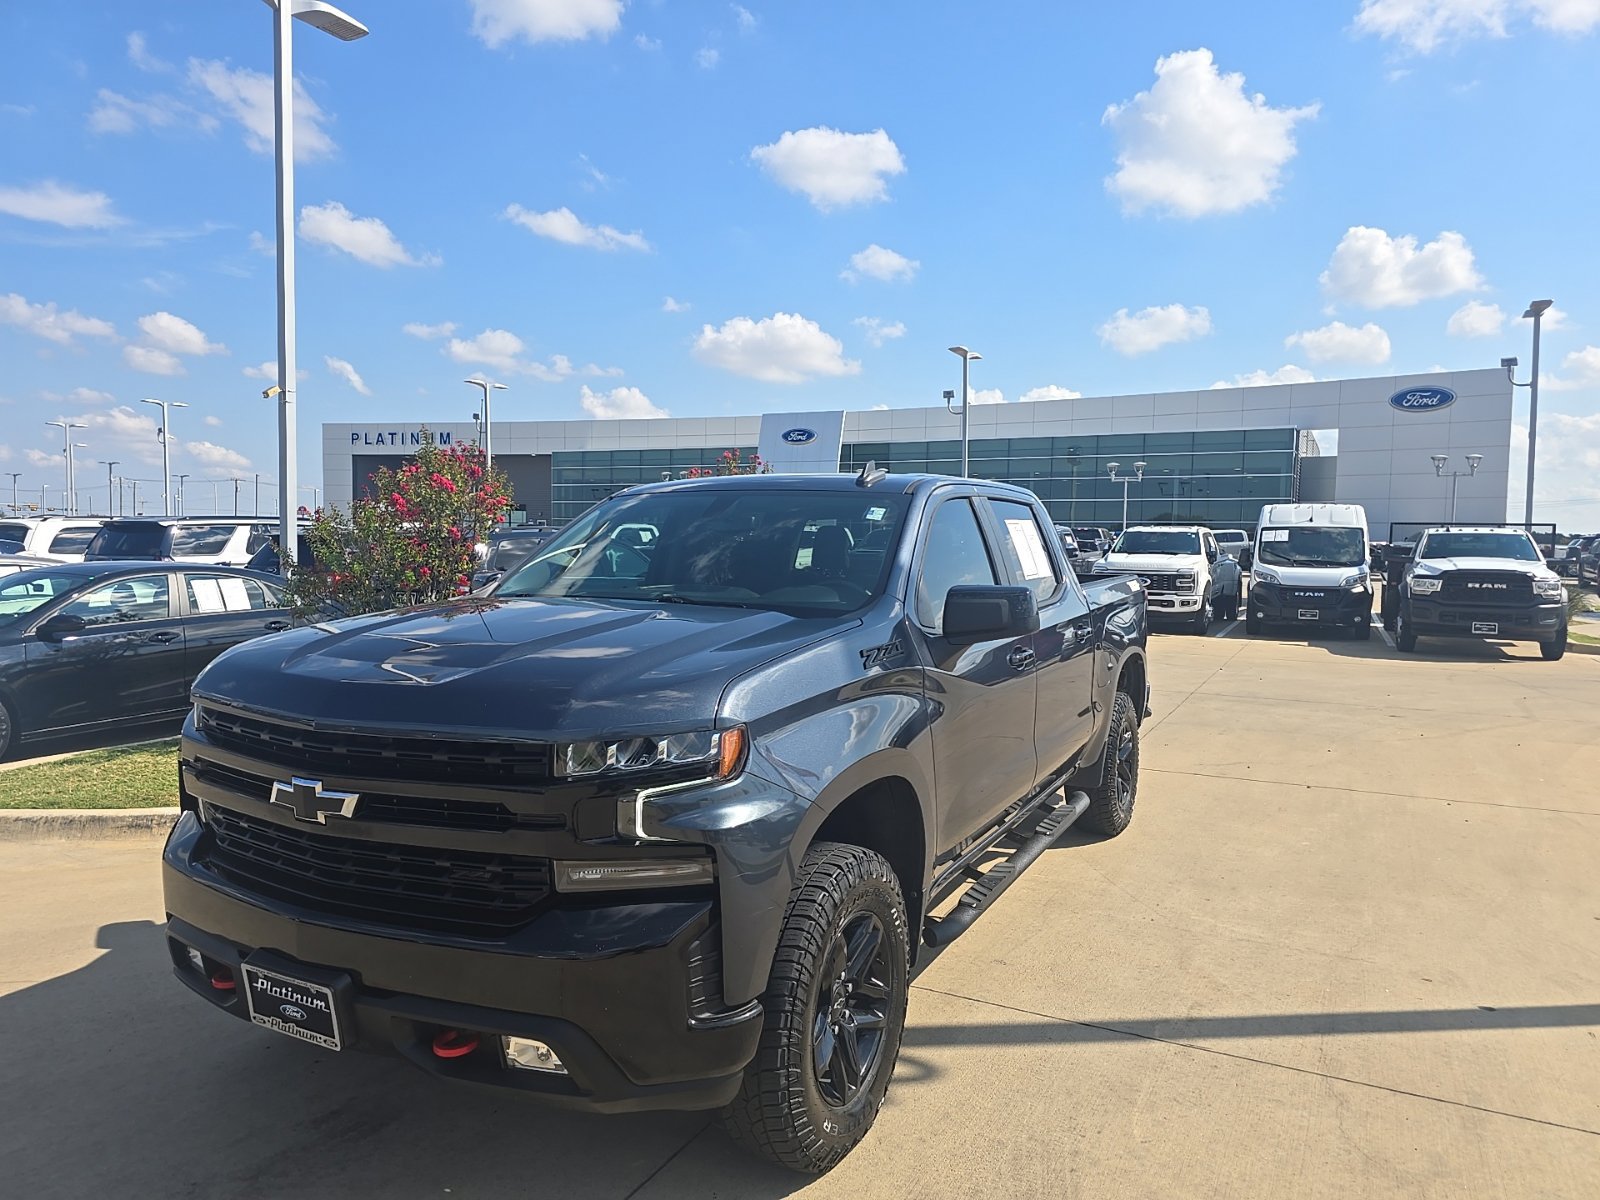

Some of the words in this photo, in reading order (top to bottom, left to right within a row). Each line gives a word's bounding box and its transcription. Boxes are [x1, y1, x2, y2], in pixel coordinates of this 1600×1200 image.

[1402, 391, 1441, 407] Ford
[787, 431, 808, 441] Ford
[252, 978, 331, 1013] Platinum
[270, 1017, 322, 1043] Platinum
